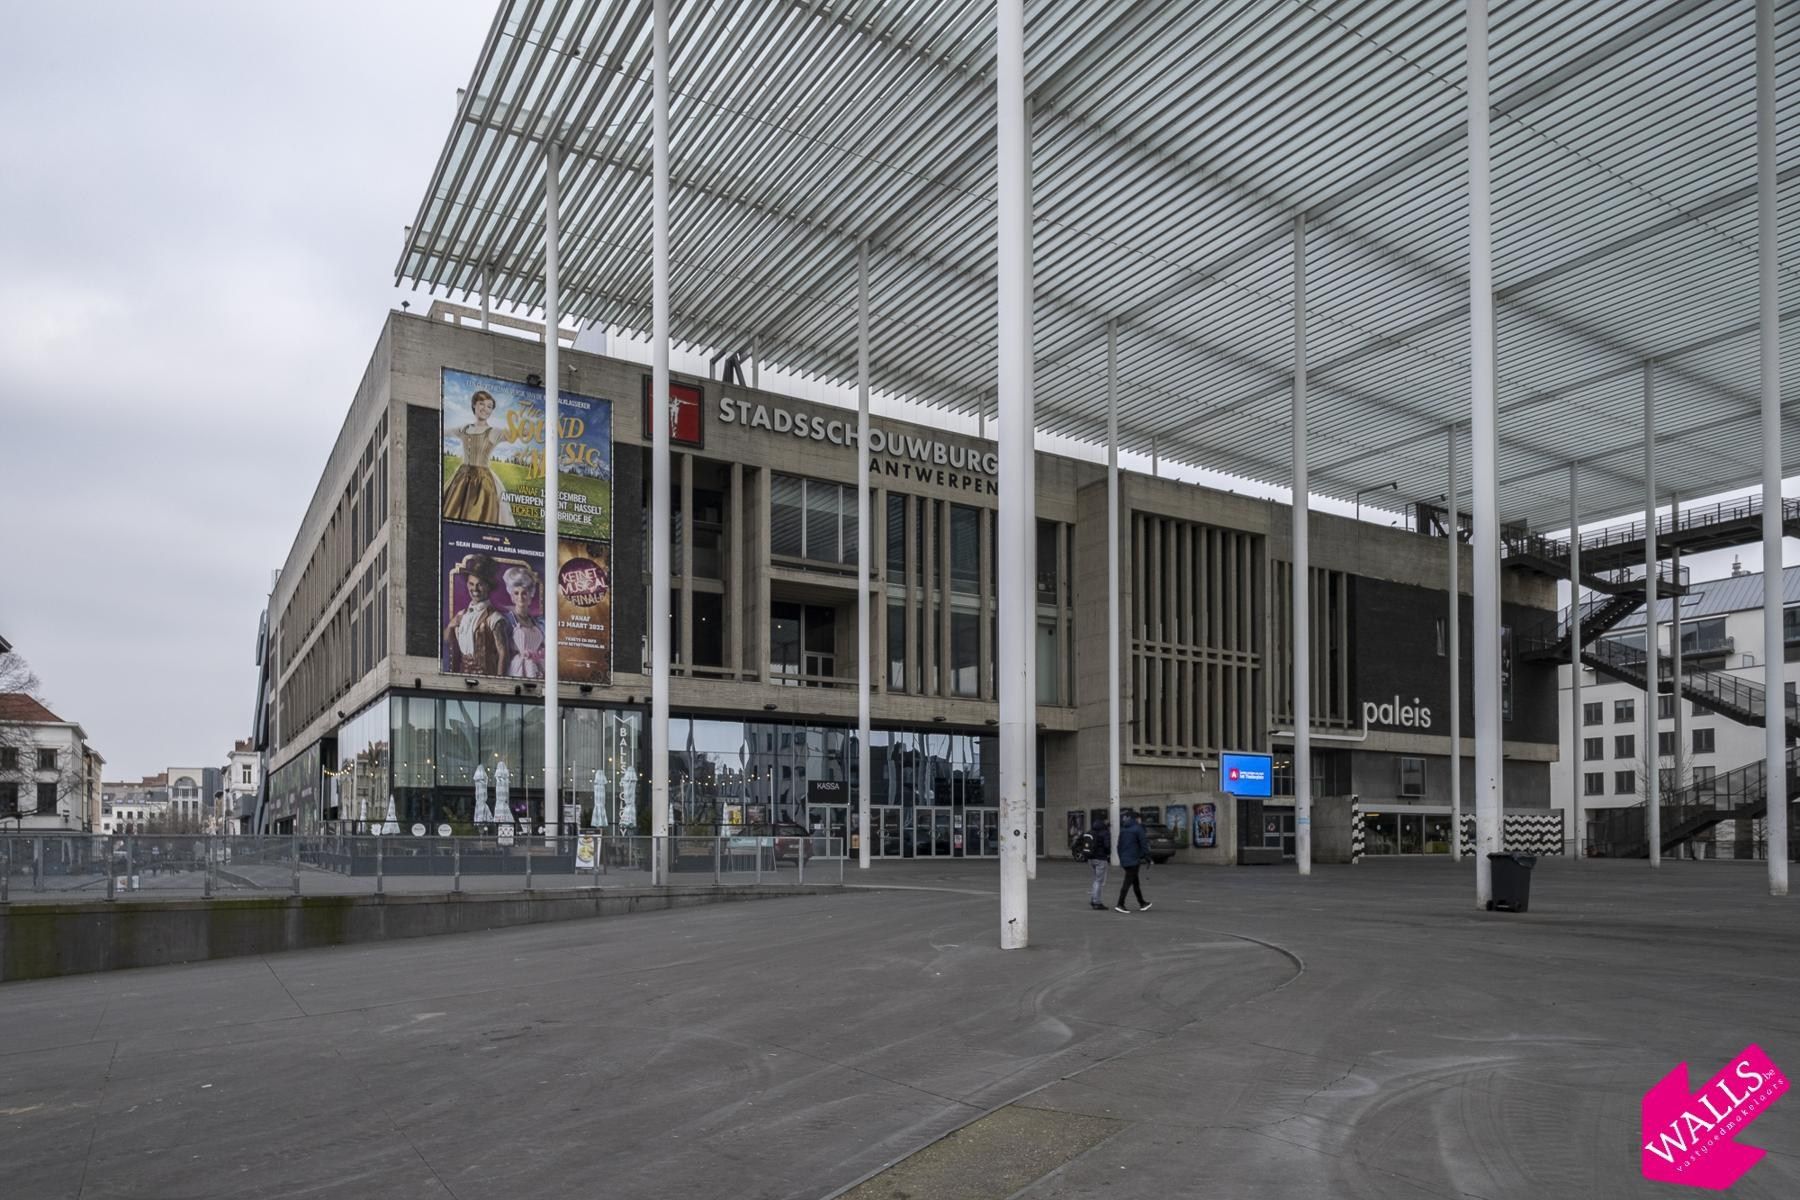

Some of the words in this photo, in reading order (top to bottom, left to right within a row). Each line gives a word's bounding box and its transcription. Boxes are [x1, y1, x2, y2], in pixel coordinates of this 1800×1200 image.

[719, 397, 998, 475] STADSSCHOUWBURG
[869, 457, 998, 496] ANTWERPEN
[501, 491, 544, 507] ANTWERPEN
[574, 503, 602, 516] HASSELT
[559, 577, 609, 596] MUSICAL
[561, 568, 597, 584] KETNET
[566, 621, 588, 630] MAART
[571, 614, 591, 622] VANAF
[1363, 694, 1432, 733] paleis
[619, 727, 627, 774] BALLS
[816, 782, 840, 790] KASSA
